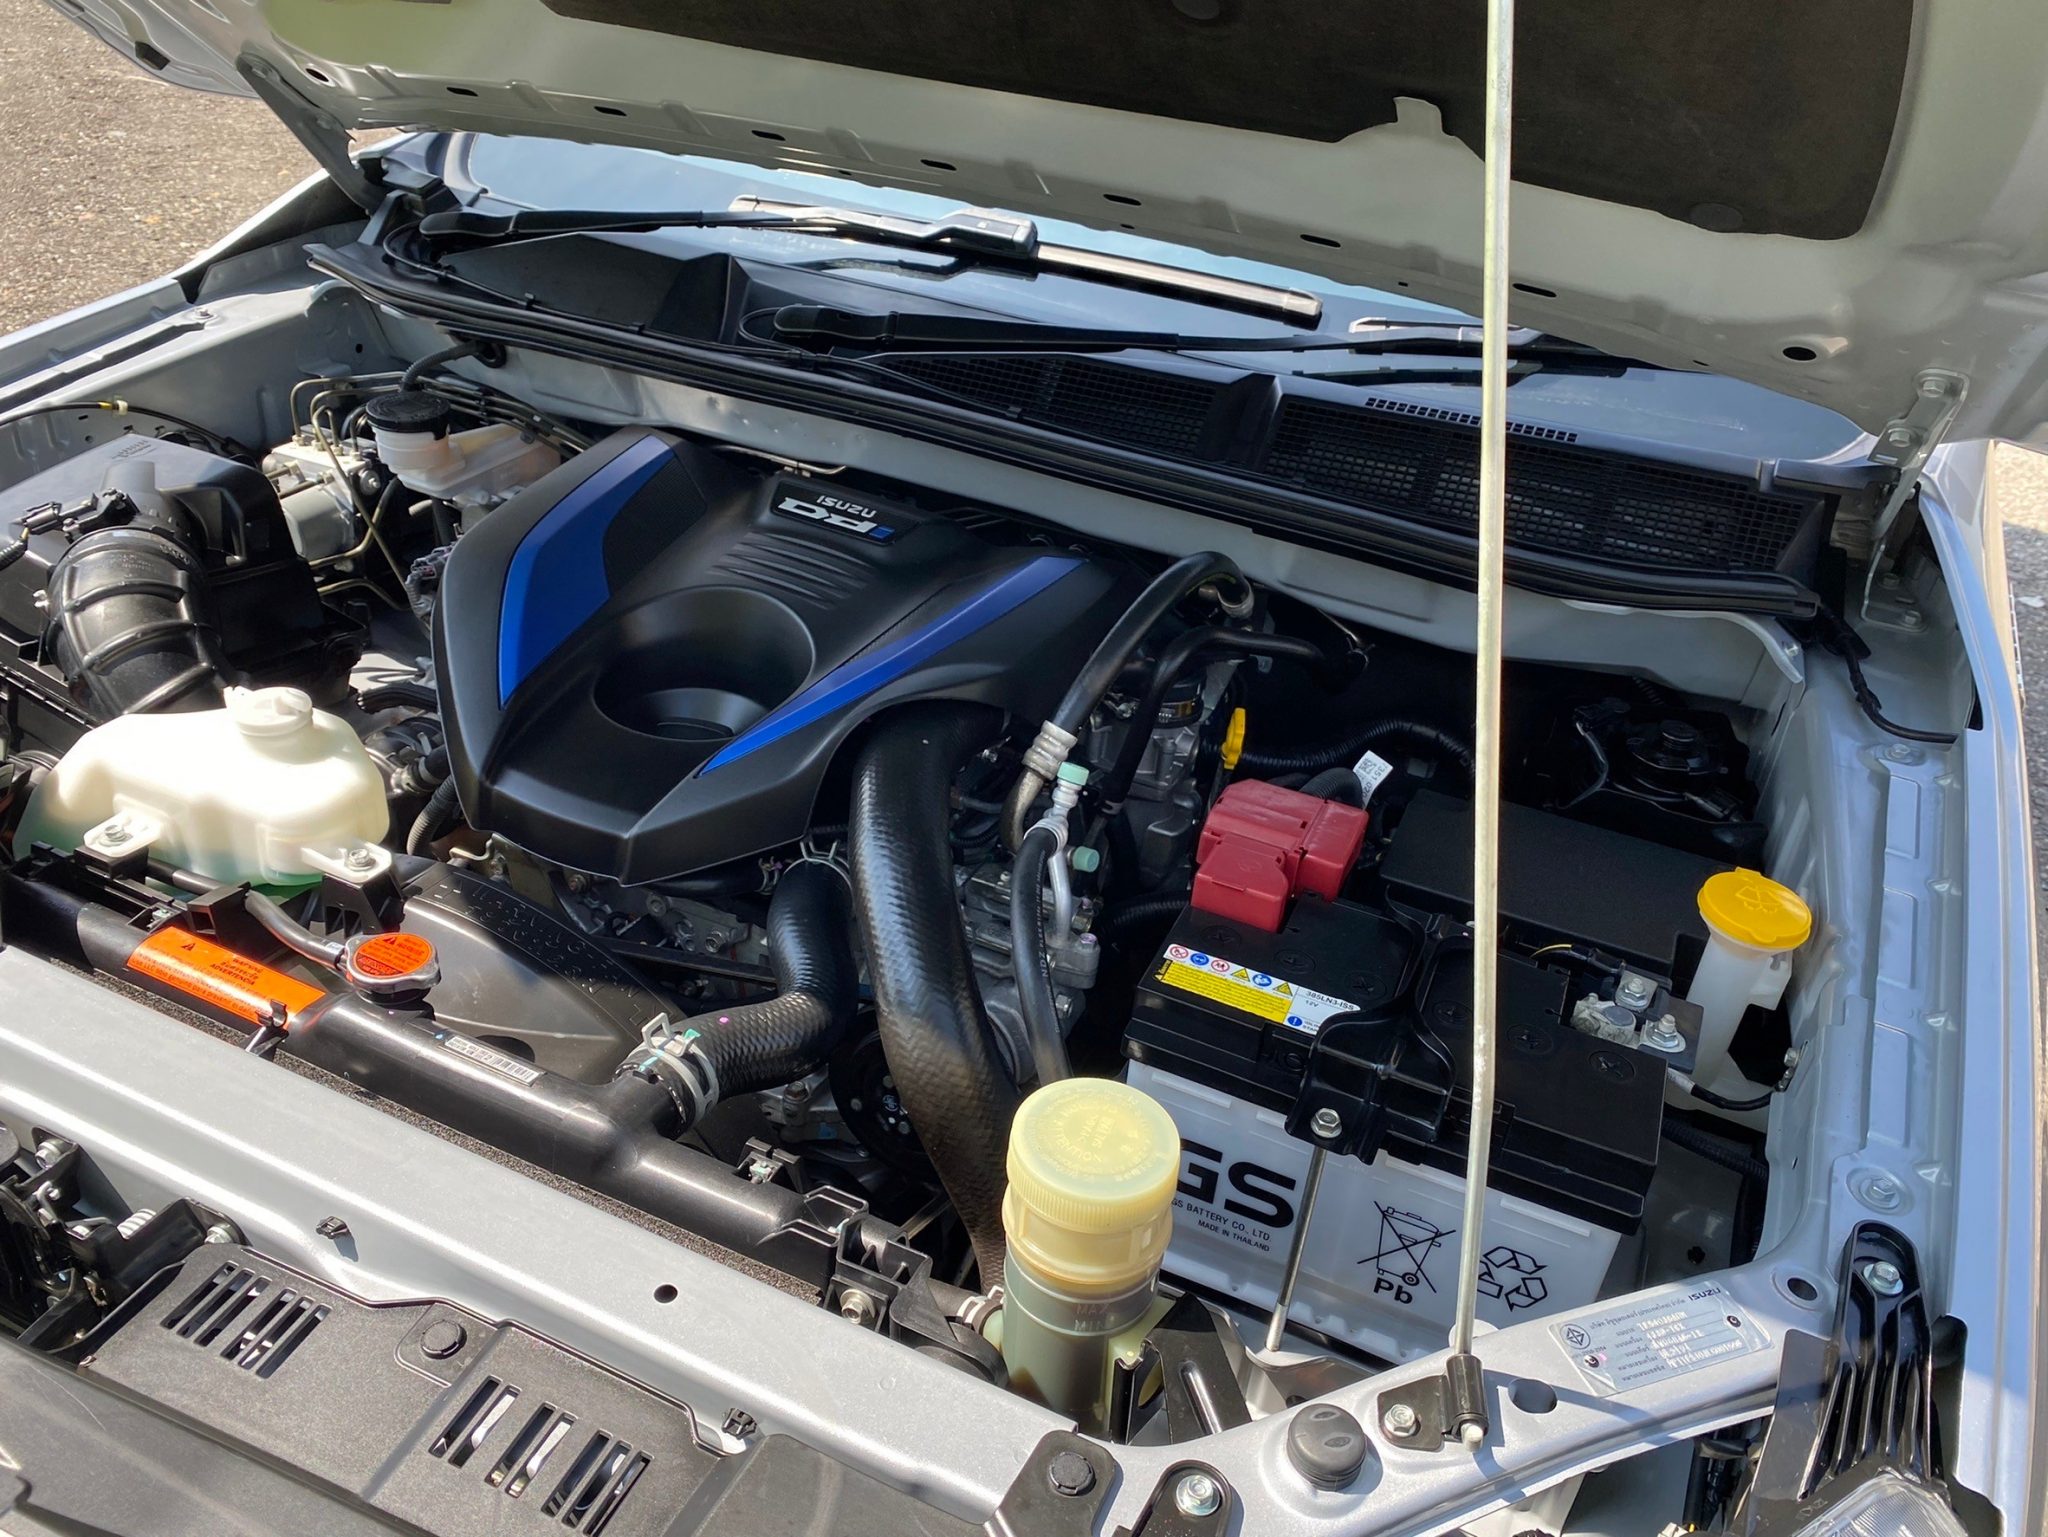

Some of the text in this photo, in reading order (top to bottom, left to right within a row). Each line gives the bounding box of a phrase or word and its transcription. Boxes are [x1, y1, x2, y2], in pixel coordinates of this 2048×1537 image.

[816, 495, 877, 519] ISUZU
[1177, 1138, 1296, 1228] GS
[1186, 1203, 1229, 1225] BATTERY
[1198, 1220, 1270, 1252] MADE IN THAILAND
[1373, 1277, 1413, 1304] Pb
[1688, 1287, 1721, 1302] ISUZU
